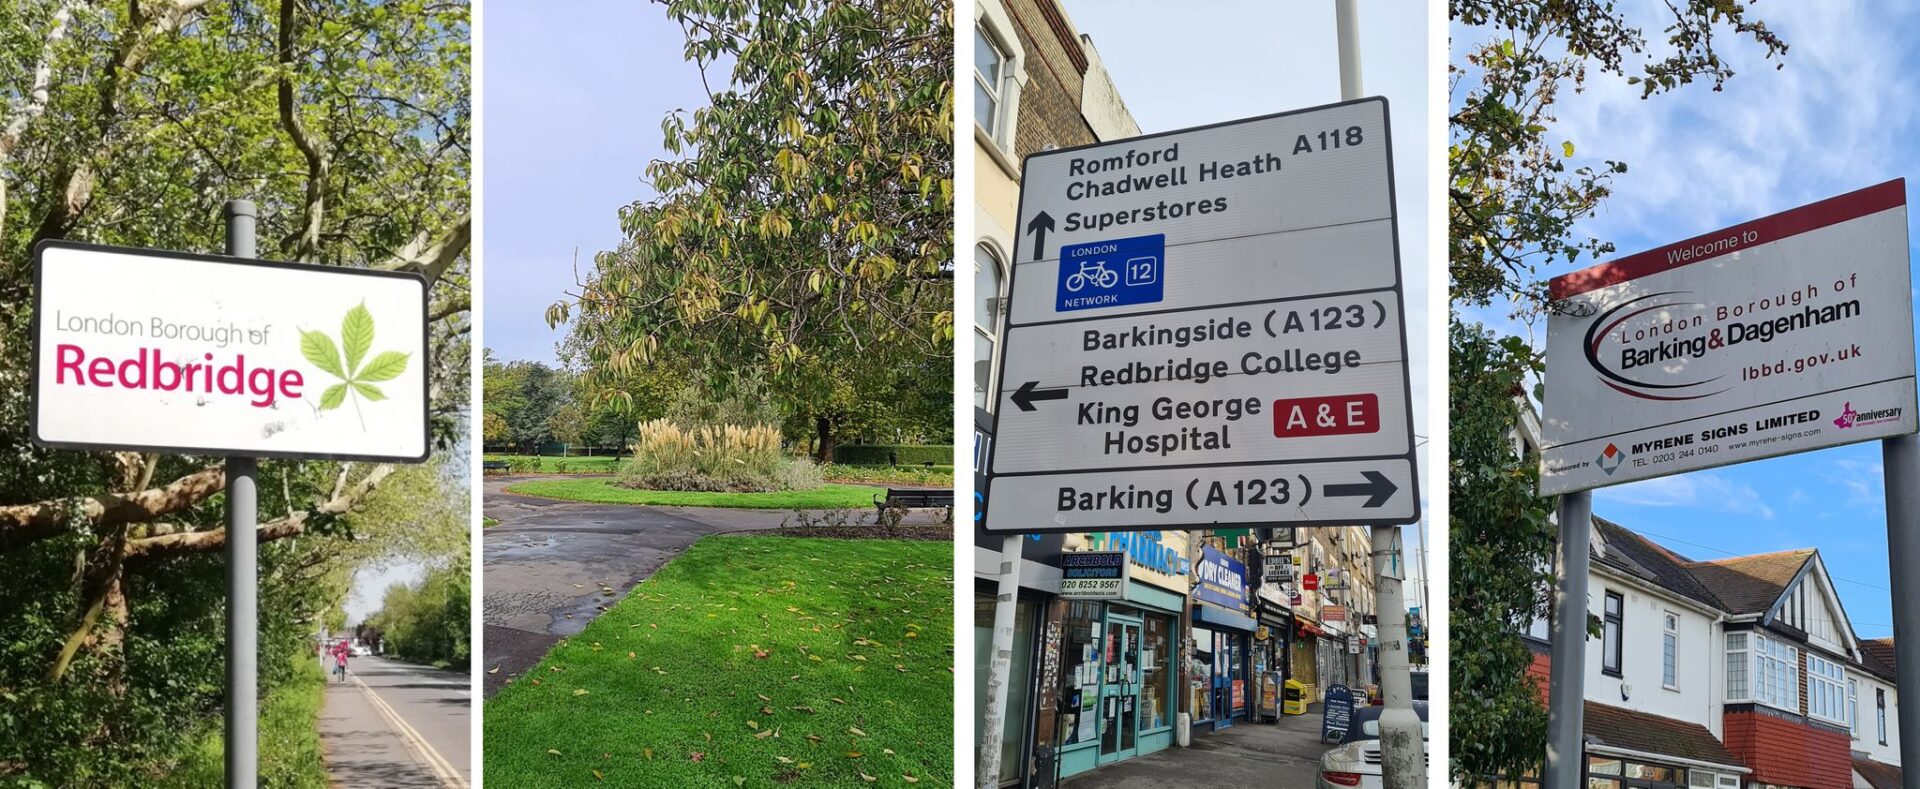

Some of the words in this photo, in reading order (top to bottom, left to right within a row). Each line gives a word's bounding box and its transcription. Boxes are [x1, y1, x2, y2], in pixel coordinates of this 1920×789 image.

[1292, 126, 1363, 155] A118
[1069, 143, 1179, 176] Romford
[1066, 166, 1187, 201] Chadwell
[1199, 153, 1282, 182] Heath
[1064, 197, 1228, 232] Superstores
[1071, 244, 1118, 258] LONDON
[1667, 235, 1738, 265] Welcome
[1742, 230, 1758, 244] to
[1130, 262, 1151, 280] 12
[1064, 294, 1118, 308] NETWORK
[1622, 314, 1702, 345] London
[1717, 284, 1818, 321] Borough
[1834, 273, 1857, 292] of
[56, 309, 143, 336] London
[151, 317, 242, 348] Borough
[249, 325, 272, 345] of
[1083, 317, 1252, 351] Barkingside
[56, 344, 304, 408] Redbridge
[1081, 357, 1228, 387] Redbridge
[1240, 349, 1361, 374] College
[1742, 344, 1862, 381] lbbd.gov.uk
[1077, 401, 1139, 427] King
[1151, 397, 1262, 421] George
[1856, 407, 1902, 422] anniversary
[1104, 425, 1231, 456] Hospital
[1631, 433, 1694, 455] MYRENE
[1701, 423, 1748, 442] SIGNS
[1756, 410, 1821, 432] LIMITED
[1728, 428, 1821, 451] www.myrene-signs.com
[1653, 453, 1675, 464] 0203
[1679, 449, 1694, 459] 244
[1698, 445, 1719, 455] 0140
[1057, 485, 1173, 512] Barking
[1063, 554, 1122, 567] ARCHBOLD
[1108, 531, 1179, 576] PHARMACY
[1061, 581, 1076, 589] 020
[1078, 580, 1098, 589] 8252
[1100, 580, 1119, 589] 9567
[1204, 559, 1218, 583] DRY
